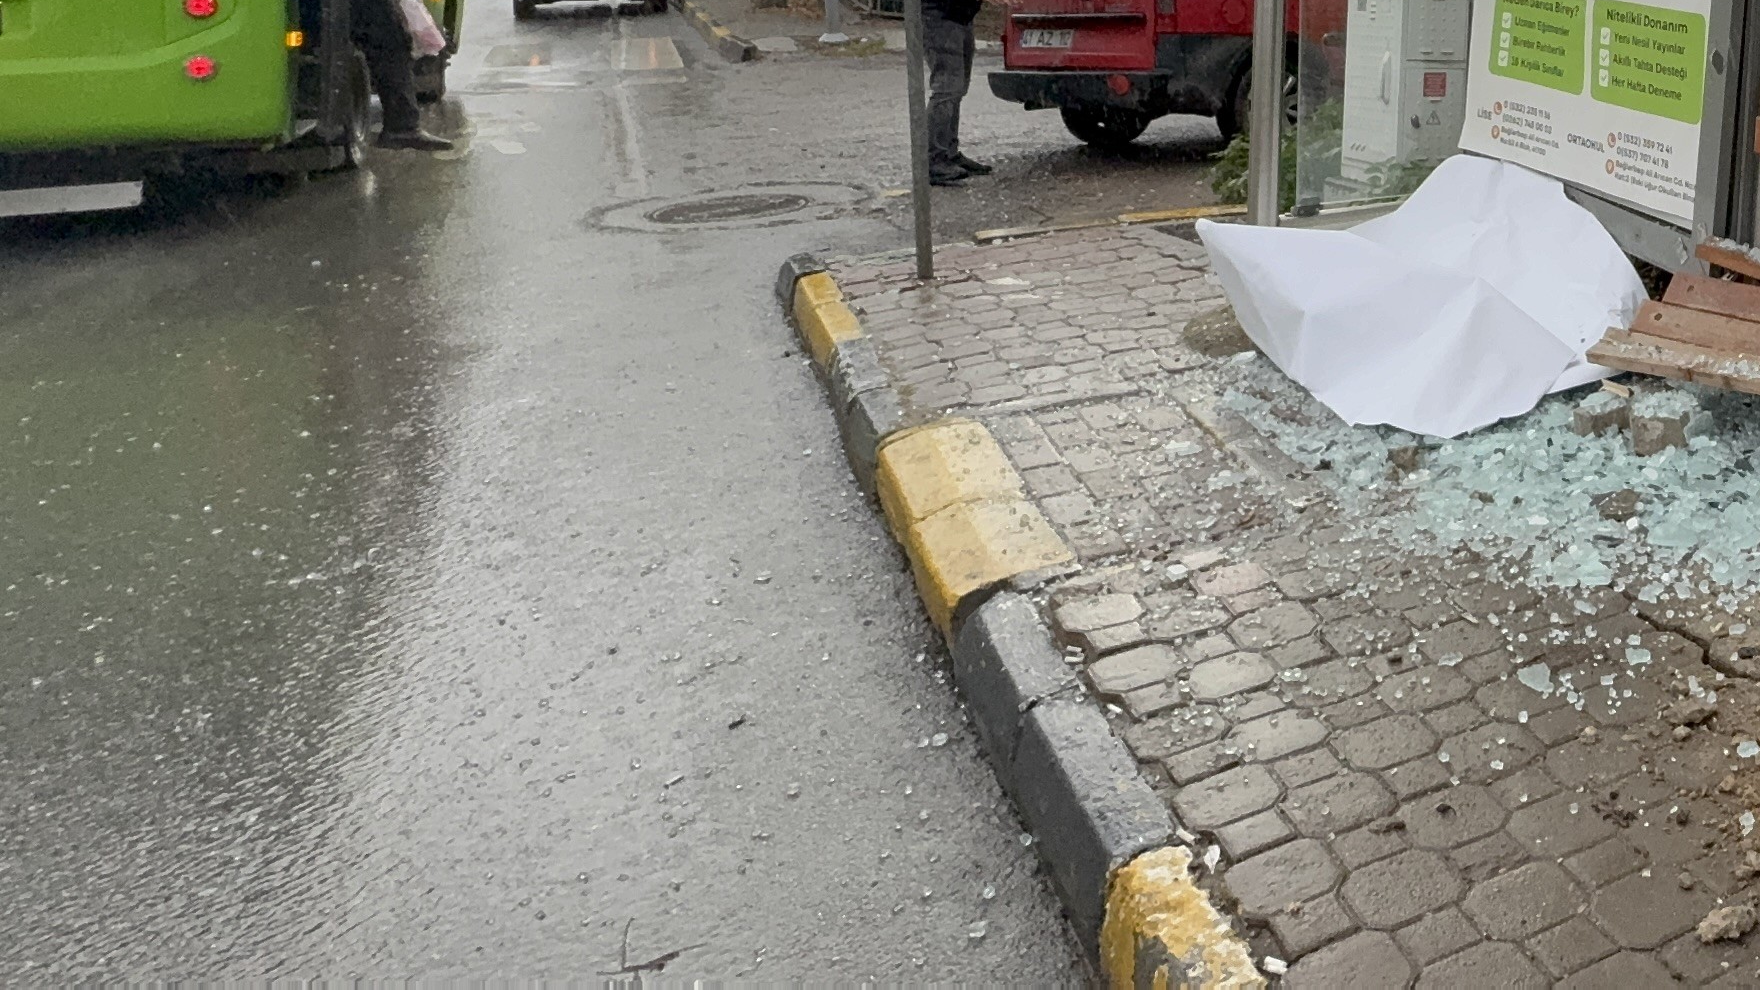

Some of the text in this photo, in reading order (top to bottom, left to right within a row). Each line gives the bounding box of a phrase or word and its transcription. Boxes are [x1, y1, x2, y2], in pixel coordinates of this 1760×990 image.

[1606, 8, 1689, 34] Nitelikli Donanım
[1652, 39, 1686, 55] Yayınlar
[1655, 62, 1688, 81] Desteği
[1648, 83, 1682, 101] Deneme
